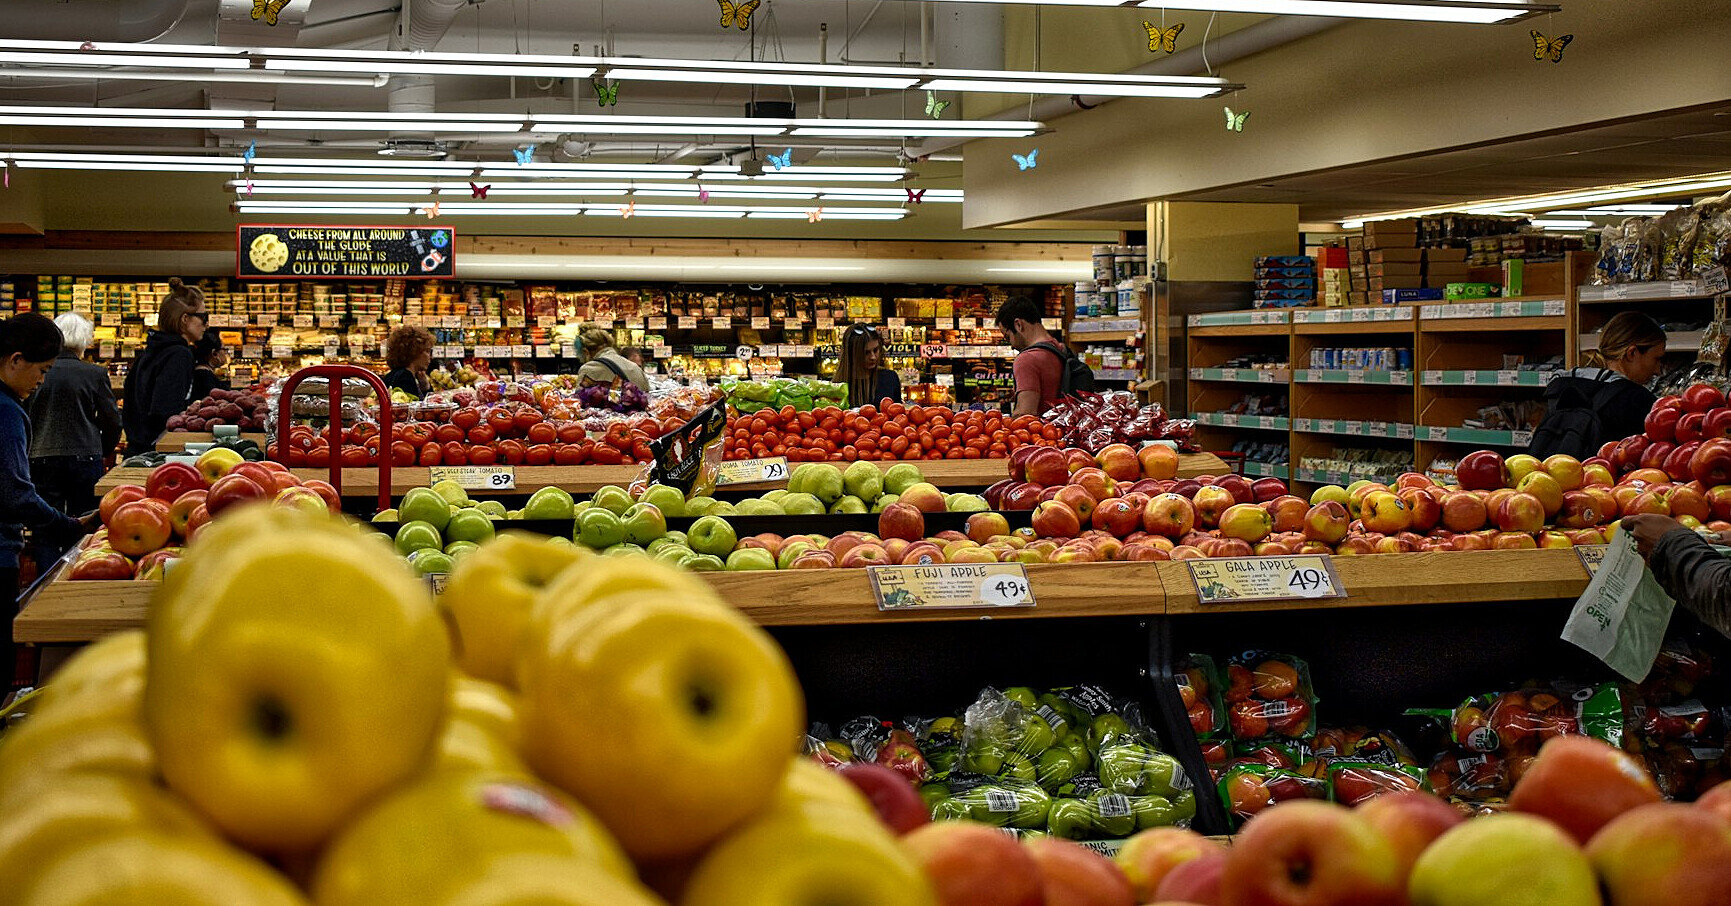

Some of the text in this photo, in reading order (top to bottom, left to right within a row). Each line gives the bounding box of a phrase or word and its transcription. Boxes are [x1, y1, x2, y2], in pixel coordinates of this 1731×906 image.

[288, 228, 406, 241] CHEESE FROM ALL AROUND
[317, 240, 372, 250] THE GLOBE
[316, 250, 347, 261] VALUE
[348, 250, 374, 261] THAT
[376, 250, 387, 261] IS
[292, 261, 410, 276] OUT OF THIS WORLD
[974, 372, 1015, 380] CHICKE
[914, 565, 988, 579] FUJI APPLE
[1225, 558, 1298, 573] GALA APPLE
[994, 580, 1027, 598] 49¢
[1586, 606, 1612, 627] OPEN
